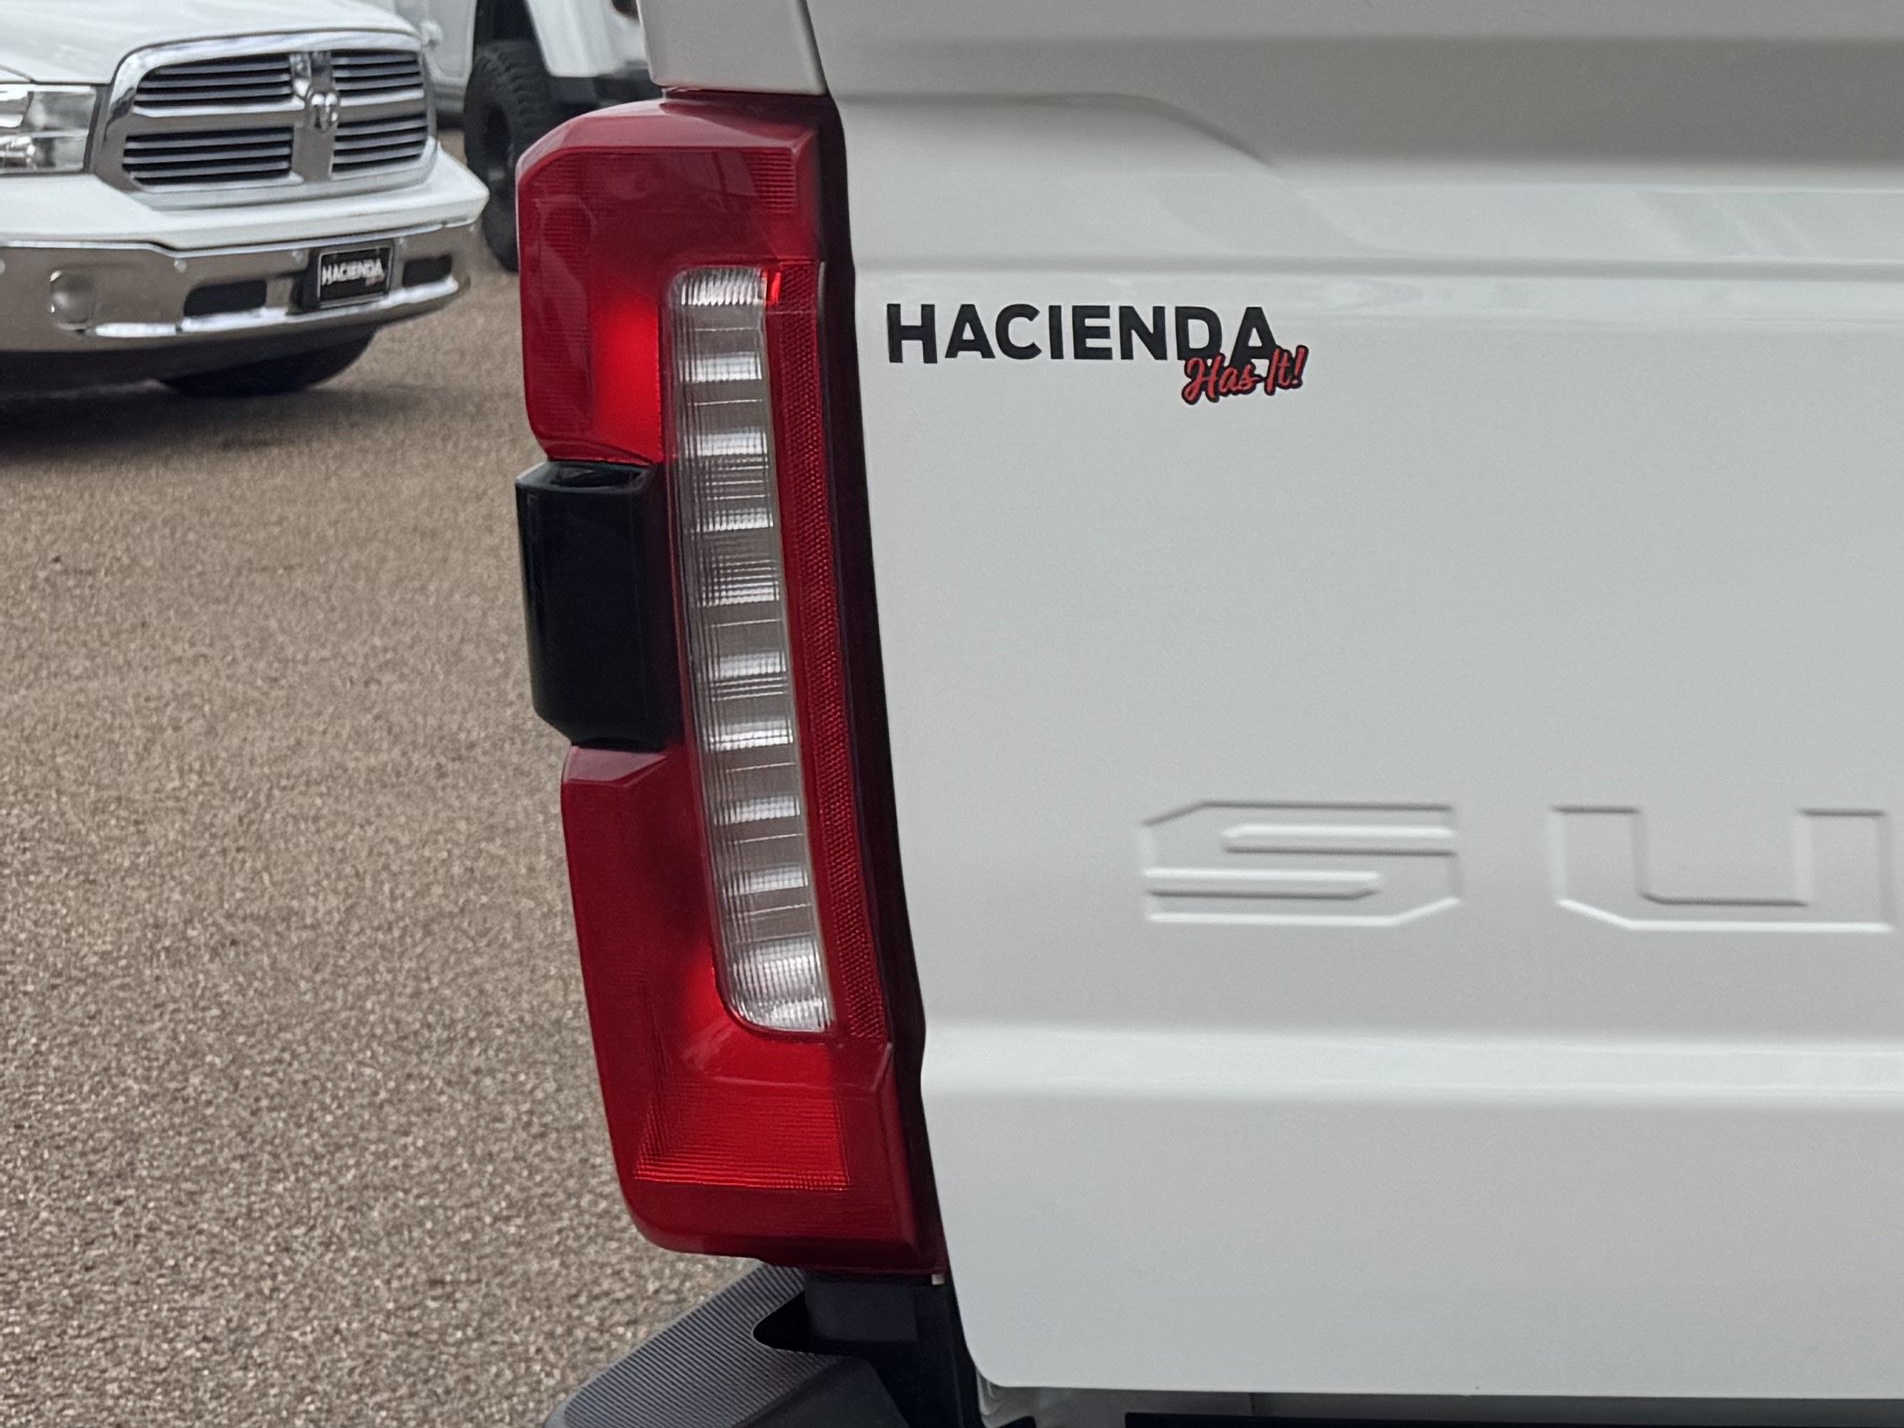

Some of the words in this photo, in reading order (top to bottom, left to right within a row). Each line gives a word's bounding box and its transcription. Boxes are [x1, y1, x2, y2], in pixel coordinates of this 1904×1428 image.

[886, 303, 1281, 366] HACIENDA
[1181, 353, 1258, 406] Has
[1263, 345, 1309, 396] It!
